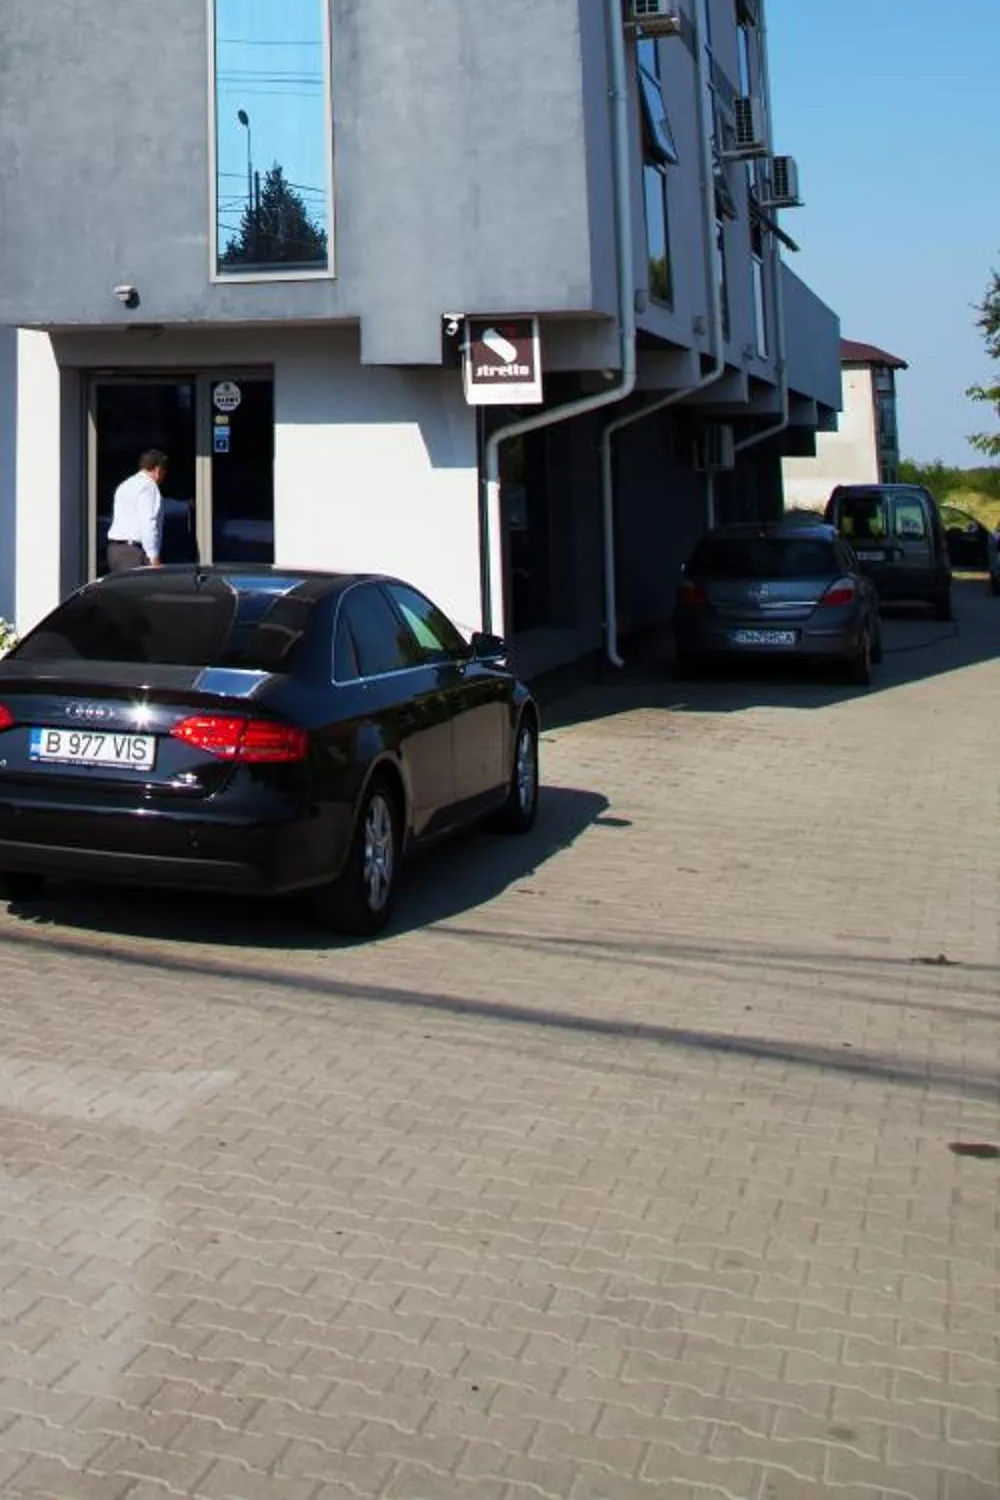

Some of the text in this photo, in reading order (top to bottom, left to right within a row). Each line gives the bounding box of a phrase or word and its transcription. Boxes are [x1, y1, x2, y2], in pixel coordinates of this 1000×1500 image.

[45, 731, 147, 761] B 977 VIS
